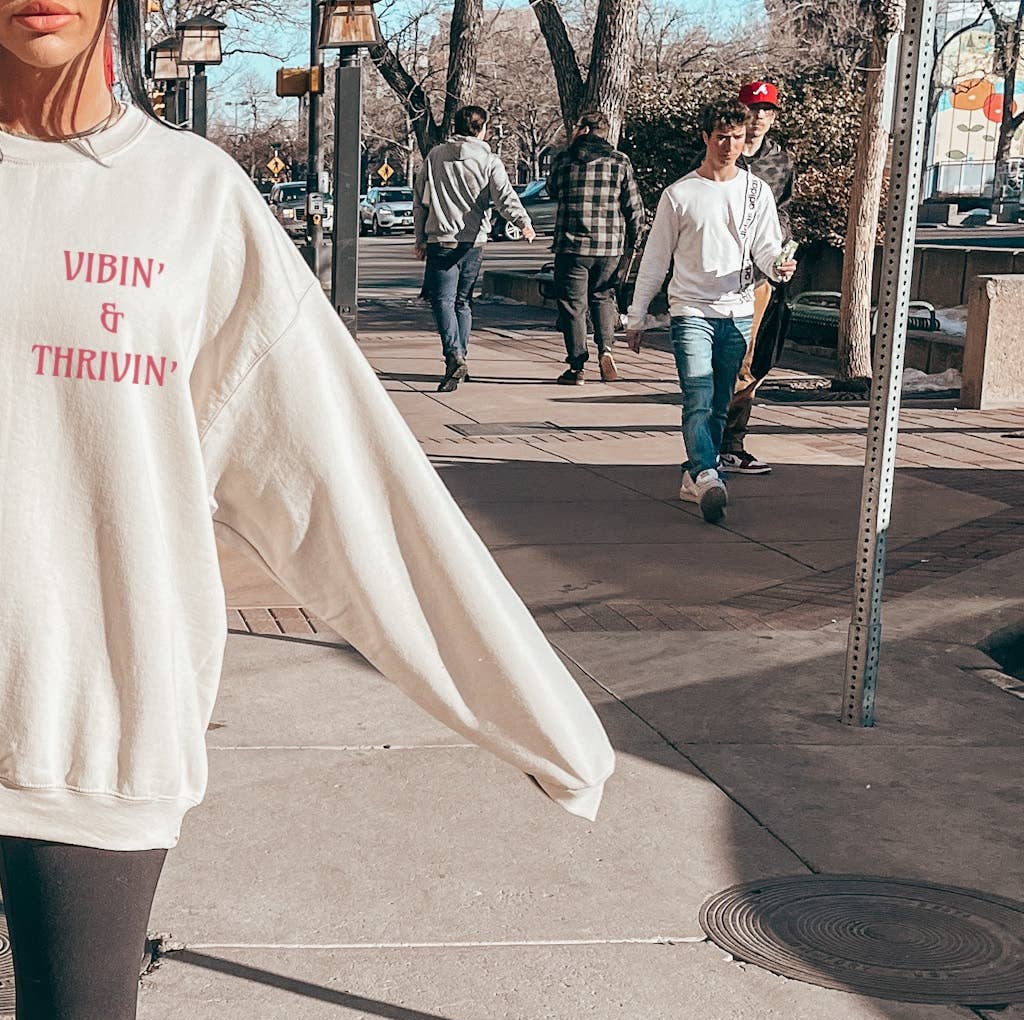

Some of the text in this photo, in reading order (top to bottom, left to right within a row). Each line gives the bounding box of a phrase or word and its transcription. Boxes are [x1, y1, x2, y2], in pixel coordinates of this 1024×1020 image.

[63, 250, 166, 288] VIBIN'
[99, 302, 125, 334] &
[31, 344, 178, 387] THRIVIN'
